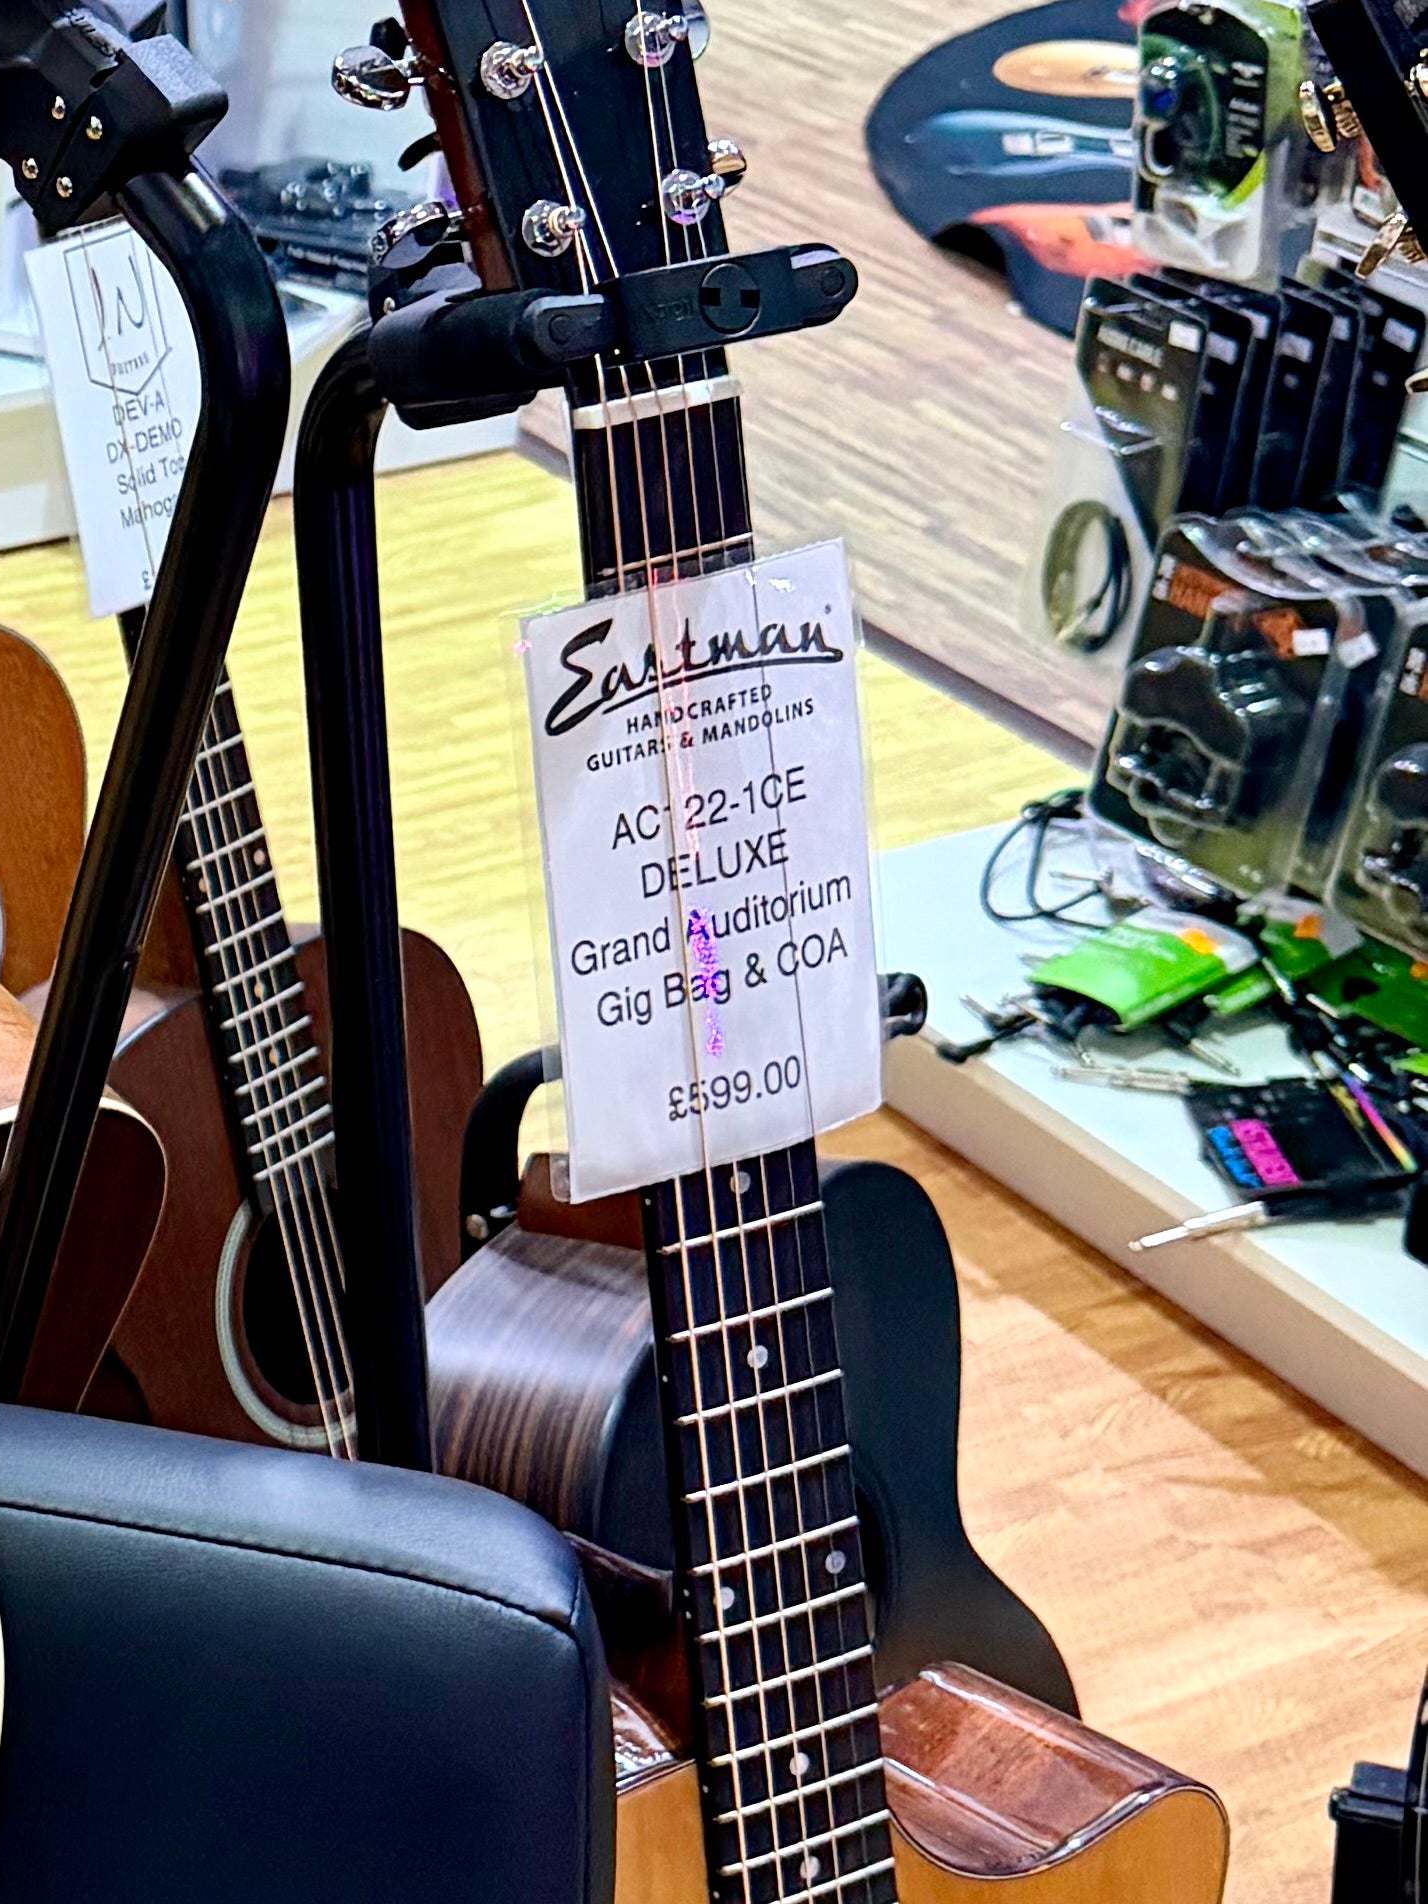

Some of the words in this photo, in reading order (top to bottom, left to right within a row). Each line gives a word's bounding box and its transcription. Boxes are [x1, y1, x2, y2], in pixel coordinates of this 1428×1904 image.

[544, 617, 844, 736] Eastman
[626, 683, 773, 734] HANDCRAFTED
[586, 736, 672, 772] GUITARS
[702, 698, 815, 746] MANDOLINS
[611, 766, 808, 850] AC22-1CE
[641, 828, 789, 898] DELUXE
[571, 916, 671, 976] Grand
[686, 874, 852, 941] Auditorium
[597, 986, 653, 1027] Gig
[664, 969, 731, 1009] Bag
[744, 953, 768, 987] &
[777, 926, 849, 978] COA
[668, 1054, 801, 1122] £599.00
